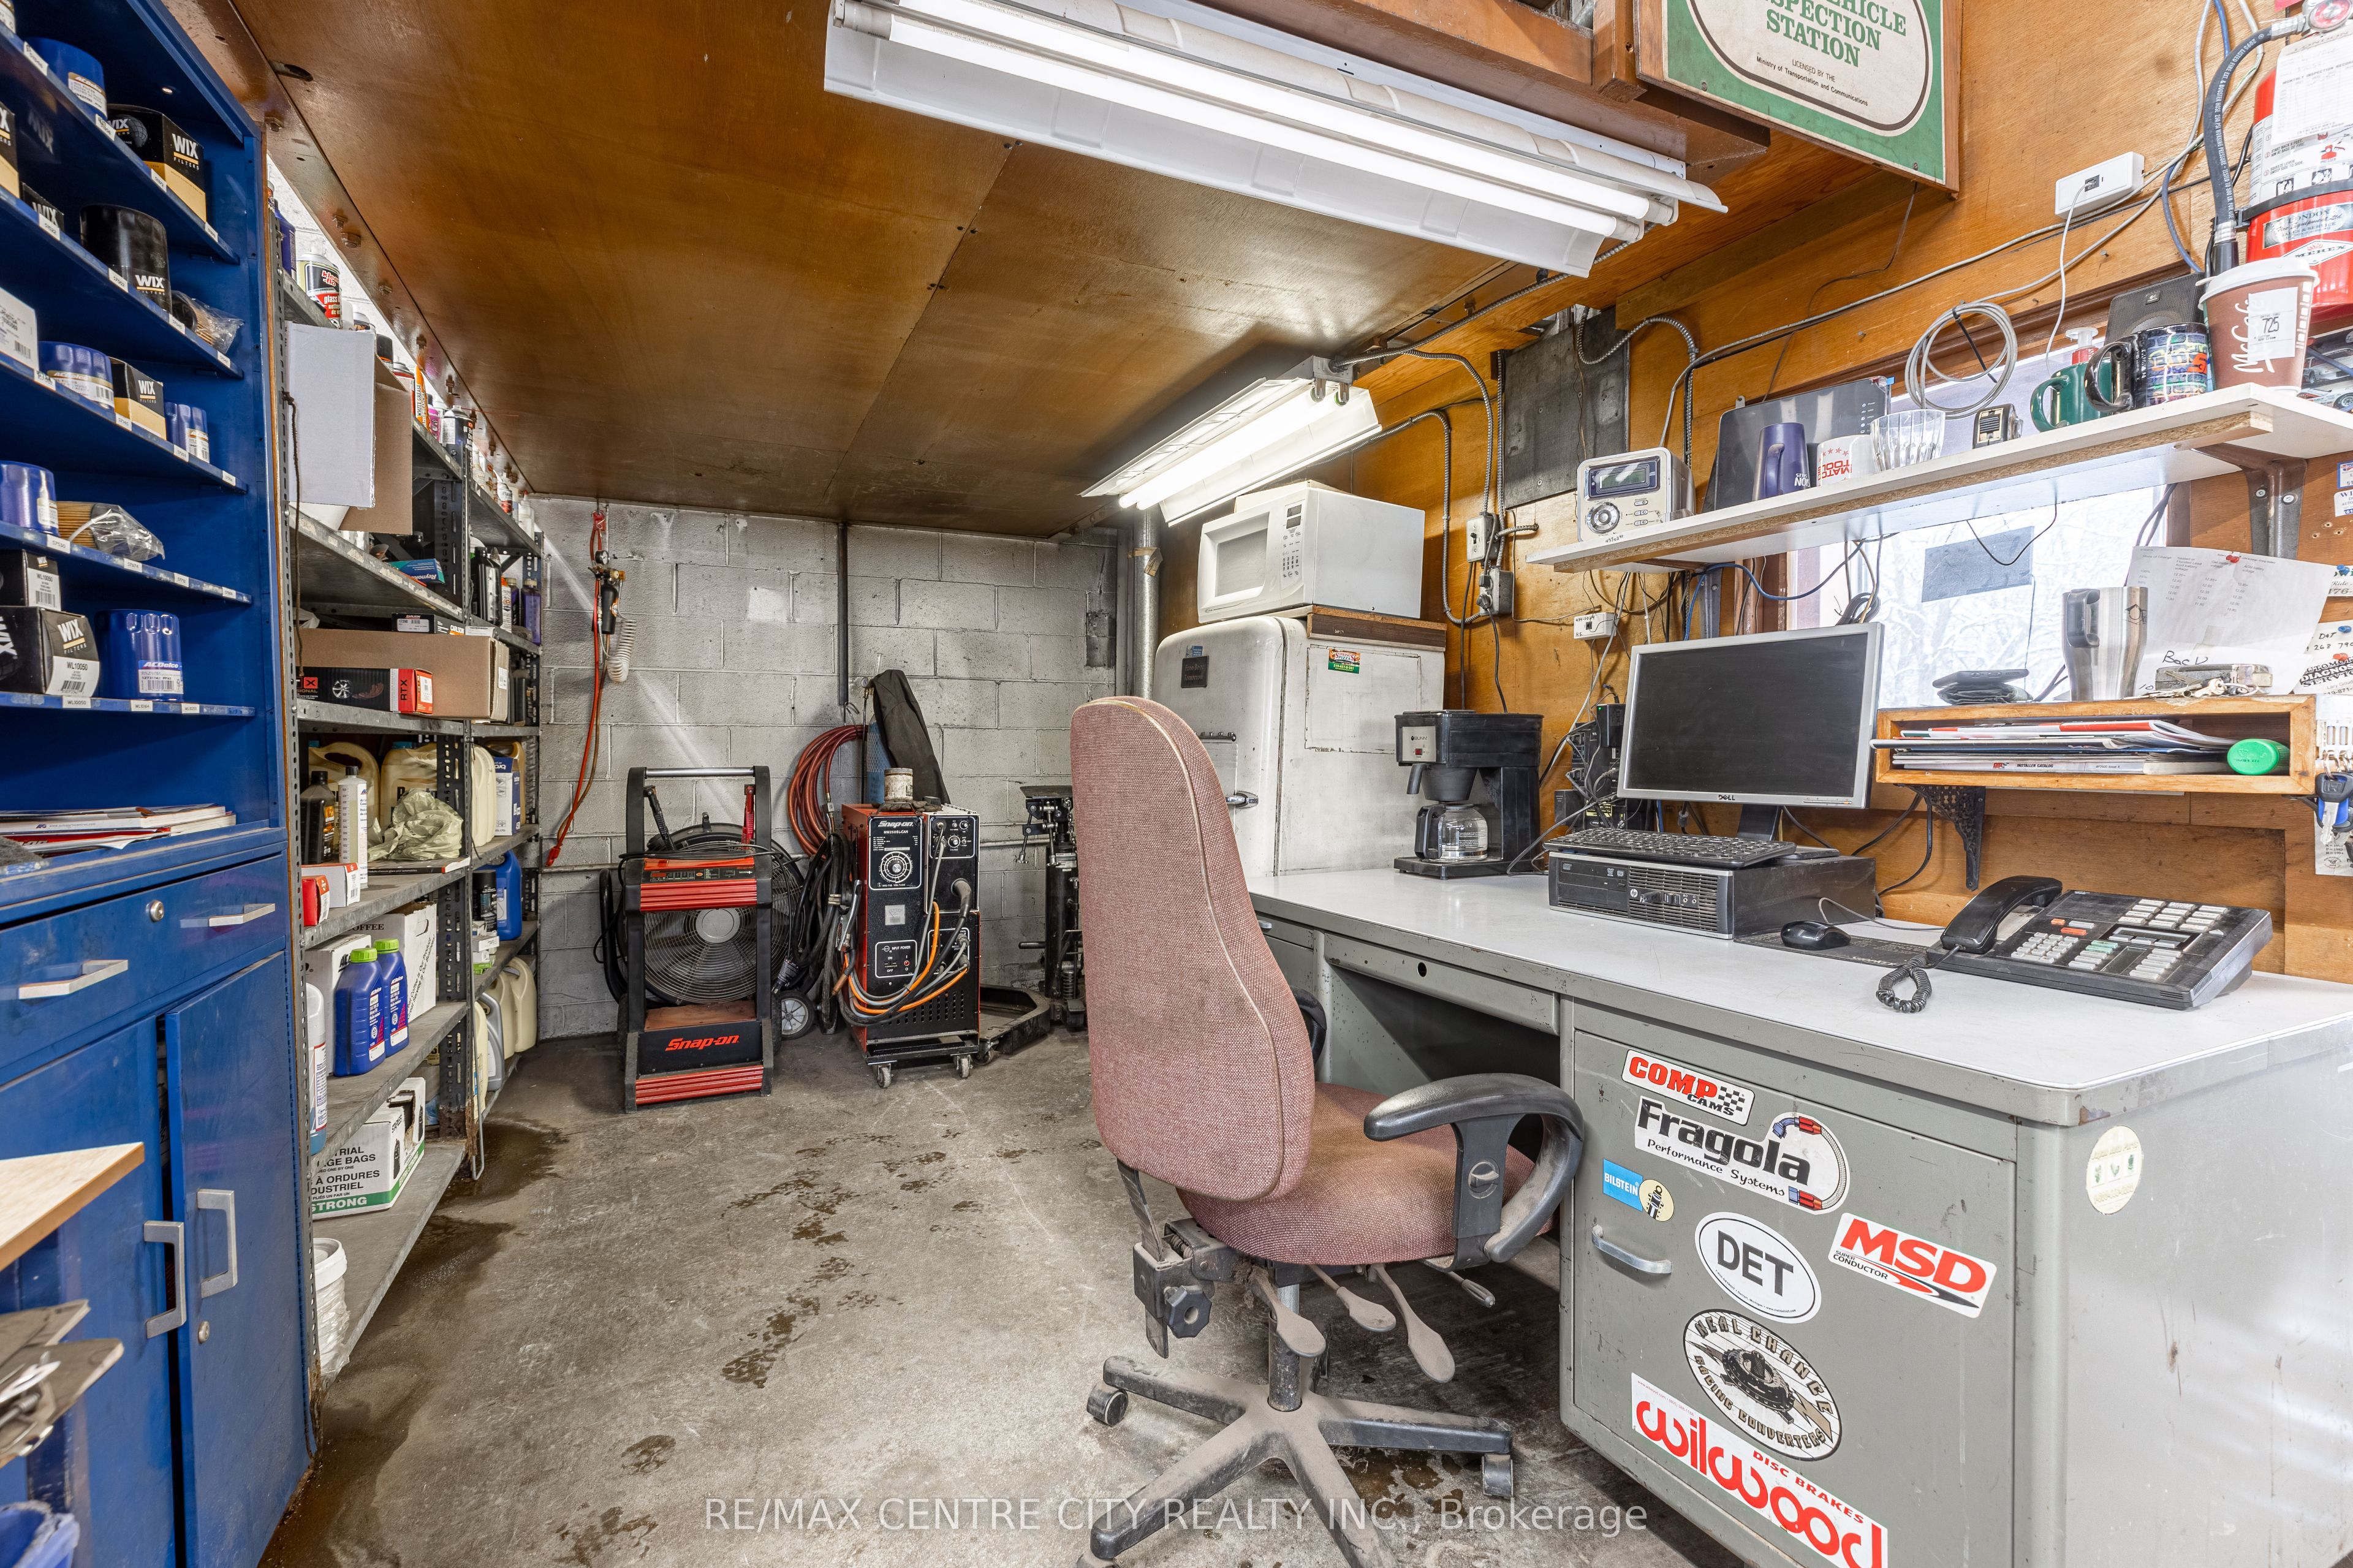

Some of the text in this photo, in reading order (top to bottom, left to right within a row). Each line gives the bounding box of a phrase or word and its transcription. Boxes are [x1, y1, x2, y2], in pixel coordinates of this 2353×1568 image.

[1767, 9, 1860, 67] STATION
[2245, 38, 2257, 51] 2095
[2232, 48, 2246, 62] LISTED
[1792, 58, 1816, 74] LICENSED
[1826, 72, 1836, 82] THE
[2227, 61, 2235, 72] FIRE
[1756, 56, 1776, 70] Ministry
[1785, 67, 1819, 86] Transportation
[1821, 80, 1830, 91] and
[1830, 86, 1868, 107] Communications
[2216, 83, 2226, 102] BOOSTER
[172, 133, 199, 159] WIX
[2215, 129, 2224, 147] WORKING
[174, 157, 199, 170] FILTERS
[2218, 146, 2227, 166] PRESSURE
[2222, 168, 2230, 183] TESTED
[32, 202, 58, 226] WIX
[2288, 209, 2330, 224] LONDON
[2295, 245, 2346, 258] MEREX
[135, 275, 165, 289] WIX
[2262, 316, 2279, 334] 725
[138, 379, 156, 395] WIX
[1817, 460, 1850, 472] TOOLS
[1817, 464, 1852, 481] MATCO
[58, 619, 84, 643] WIX
[450, 624, 465, 634] CARLSON
[64, 643, 87, 655] FILTERS
[67, 661, 88, 671] WL10050
[1631, 888, 1638, 898] hp
[665, 1035, 740, 1051] Snap-on
[1629, 1056, 1718, 1099] COMP
[1687, 1093, 1734, 1116] CAMS
[1638, 1098, 1809, 1186] Fragola
[345, 1154, 376, 1165] BAGS
[1648, 1138, 1784, 1197] Performance Systems
[316, 1170, 380, 1185] À ORDURES
[1604, 1170, 1638, 1197] BILSTEIN
[311, 1196, 368, 1212] STRONG
[1718, 1230, 1794, 1297] DET
[1836, 1250, 1855, 1260] SUPER
[1840, 1218, 1987, 1293] MSD
[1833, 1254, 1888, 1279] CONDUCTOR
[1694, 1316, 1833, 1414] NEAL CHANCE
[1694, 1355, 1826, 1449] RACING CONVERTERS
[1636, 1401, 1882, 1568] wilwood
[1752, 1450, 1864, 1524] DISC BRAKES
